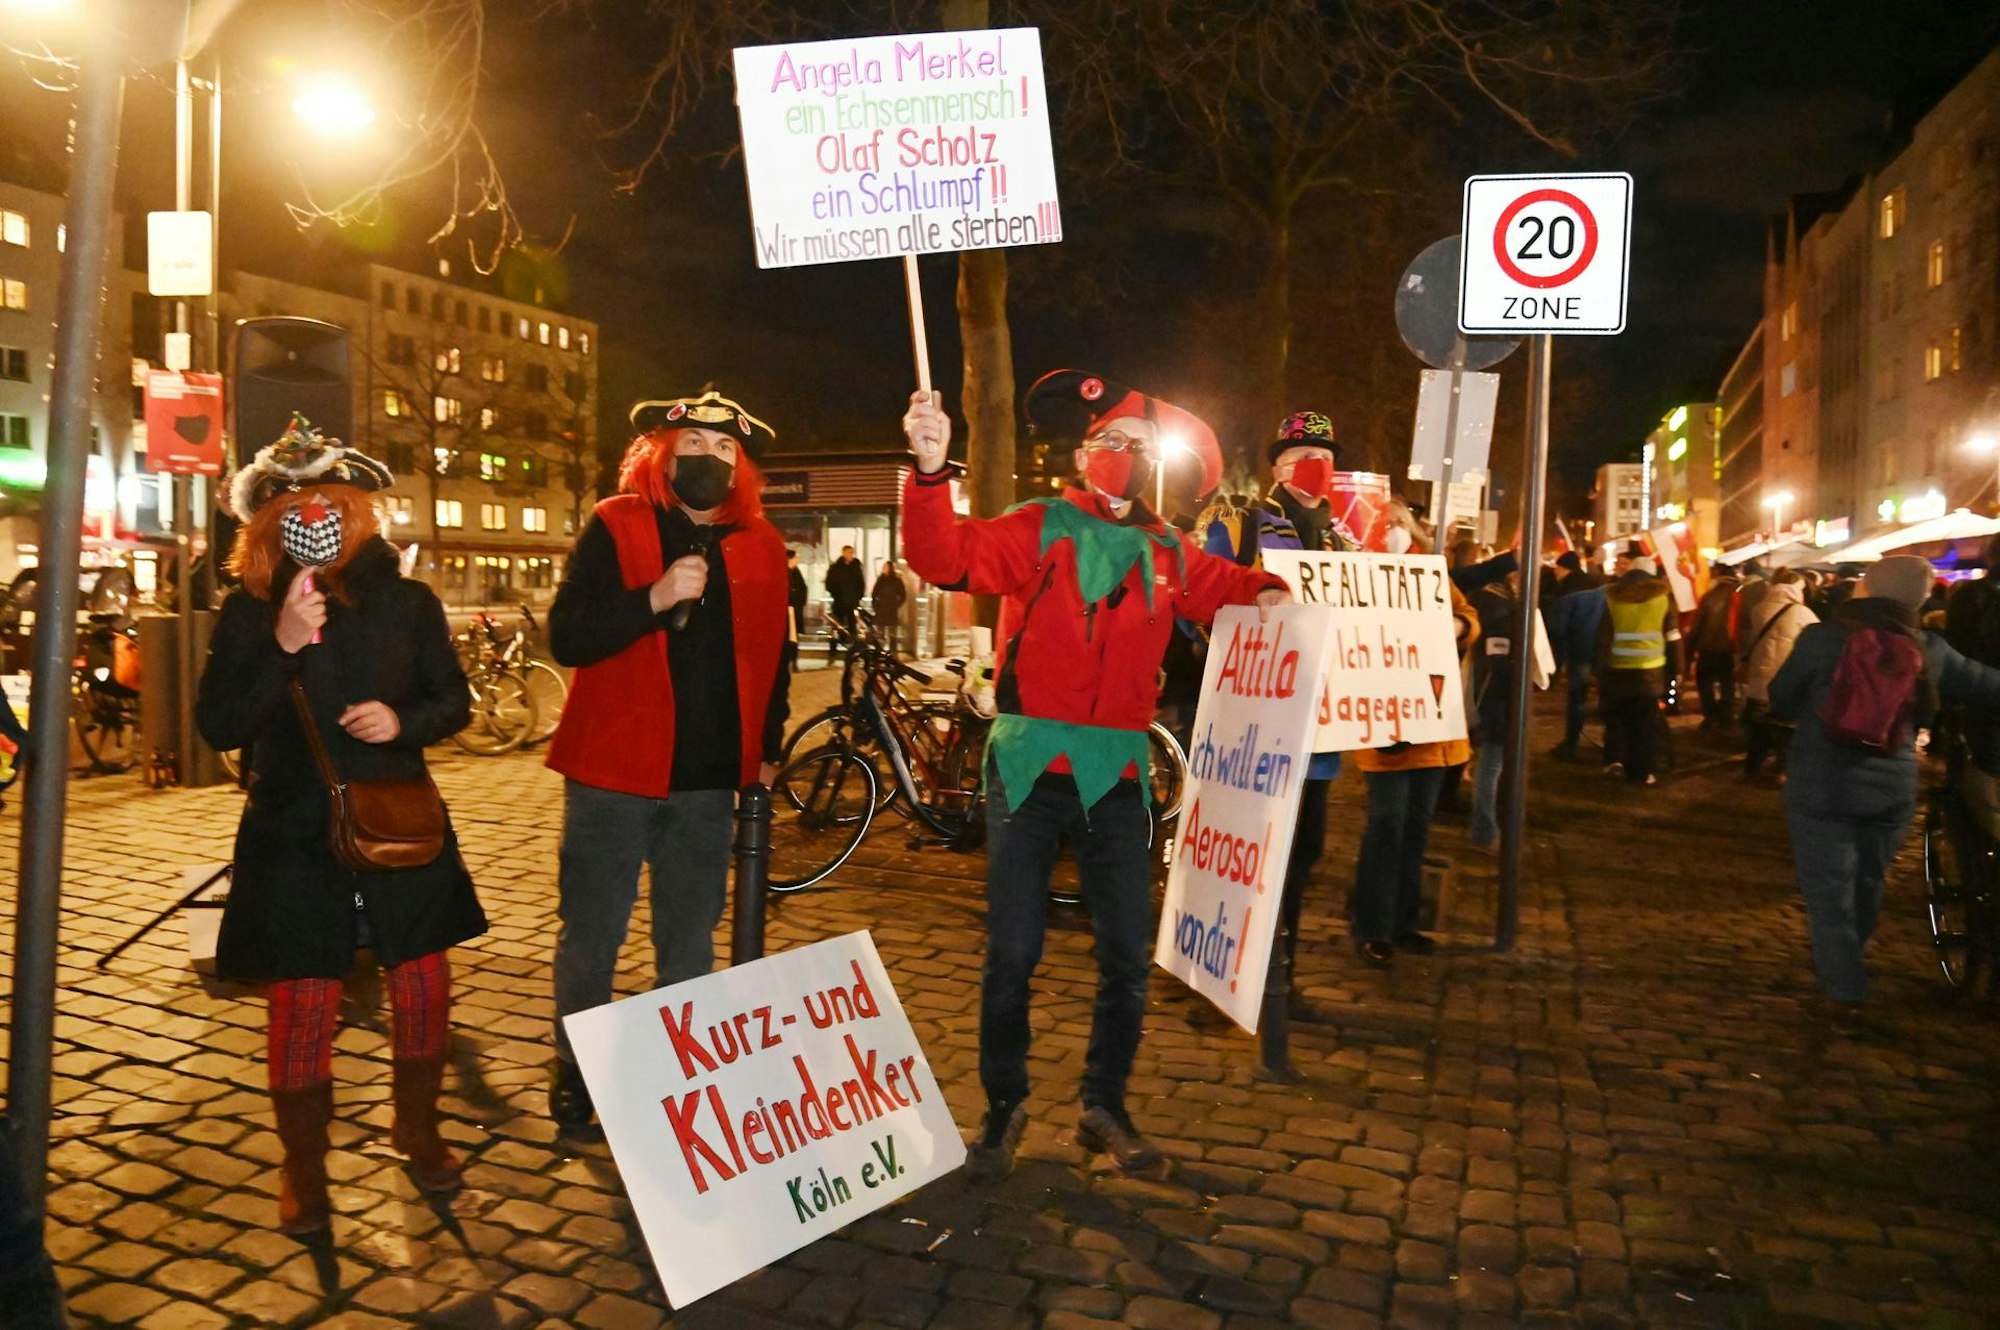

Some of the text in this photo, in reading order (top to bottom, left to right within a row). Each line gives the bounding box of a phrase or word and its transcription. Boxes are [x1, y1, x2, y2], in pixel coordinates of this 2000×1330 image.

[770, 35, 1007, 97] Angela Merkel
[785, 98, 826, 135] ein
[815, 125, 999, 175] Olaf Scholz
[811, 184, 853, 220] ein
[756, 223, 796, 266] Wir
[803, 227, 891, 263] müssen
[899, 213, 943, 252] alle
[1517, 216, 1575, 259] 20
[1502, 297, 1581, 319] ZONE
[1216, 620, 1300, 699] Attila
[1337, 624, 1420, 670] Ich bin
[1216, 723, 1259, 791] will
[1253, 737, 1292, 799] ein
[1179, 797, 1273, 895] Aerosol
[659, 959, 881, 1080] Kurz- und
[786, 1134, 905, 1224] Köln e.V.
